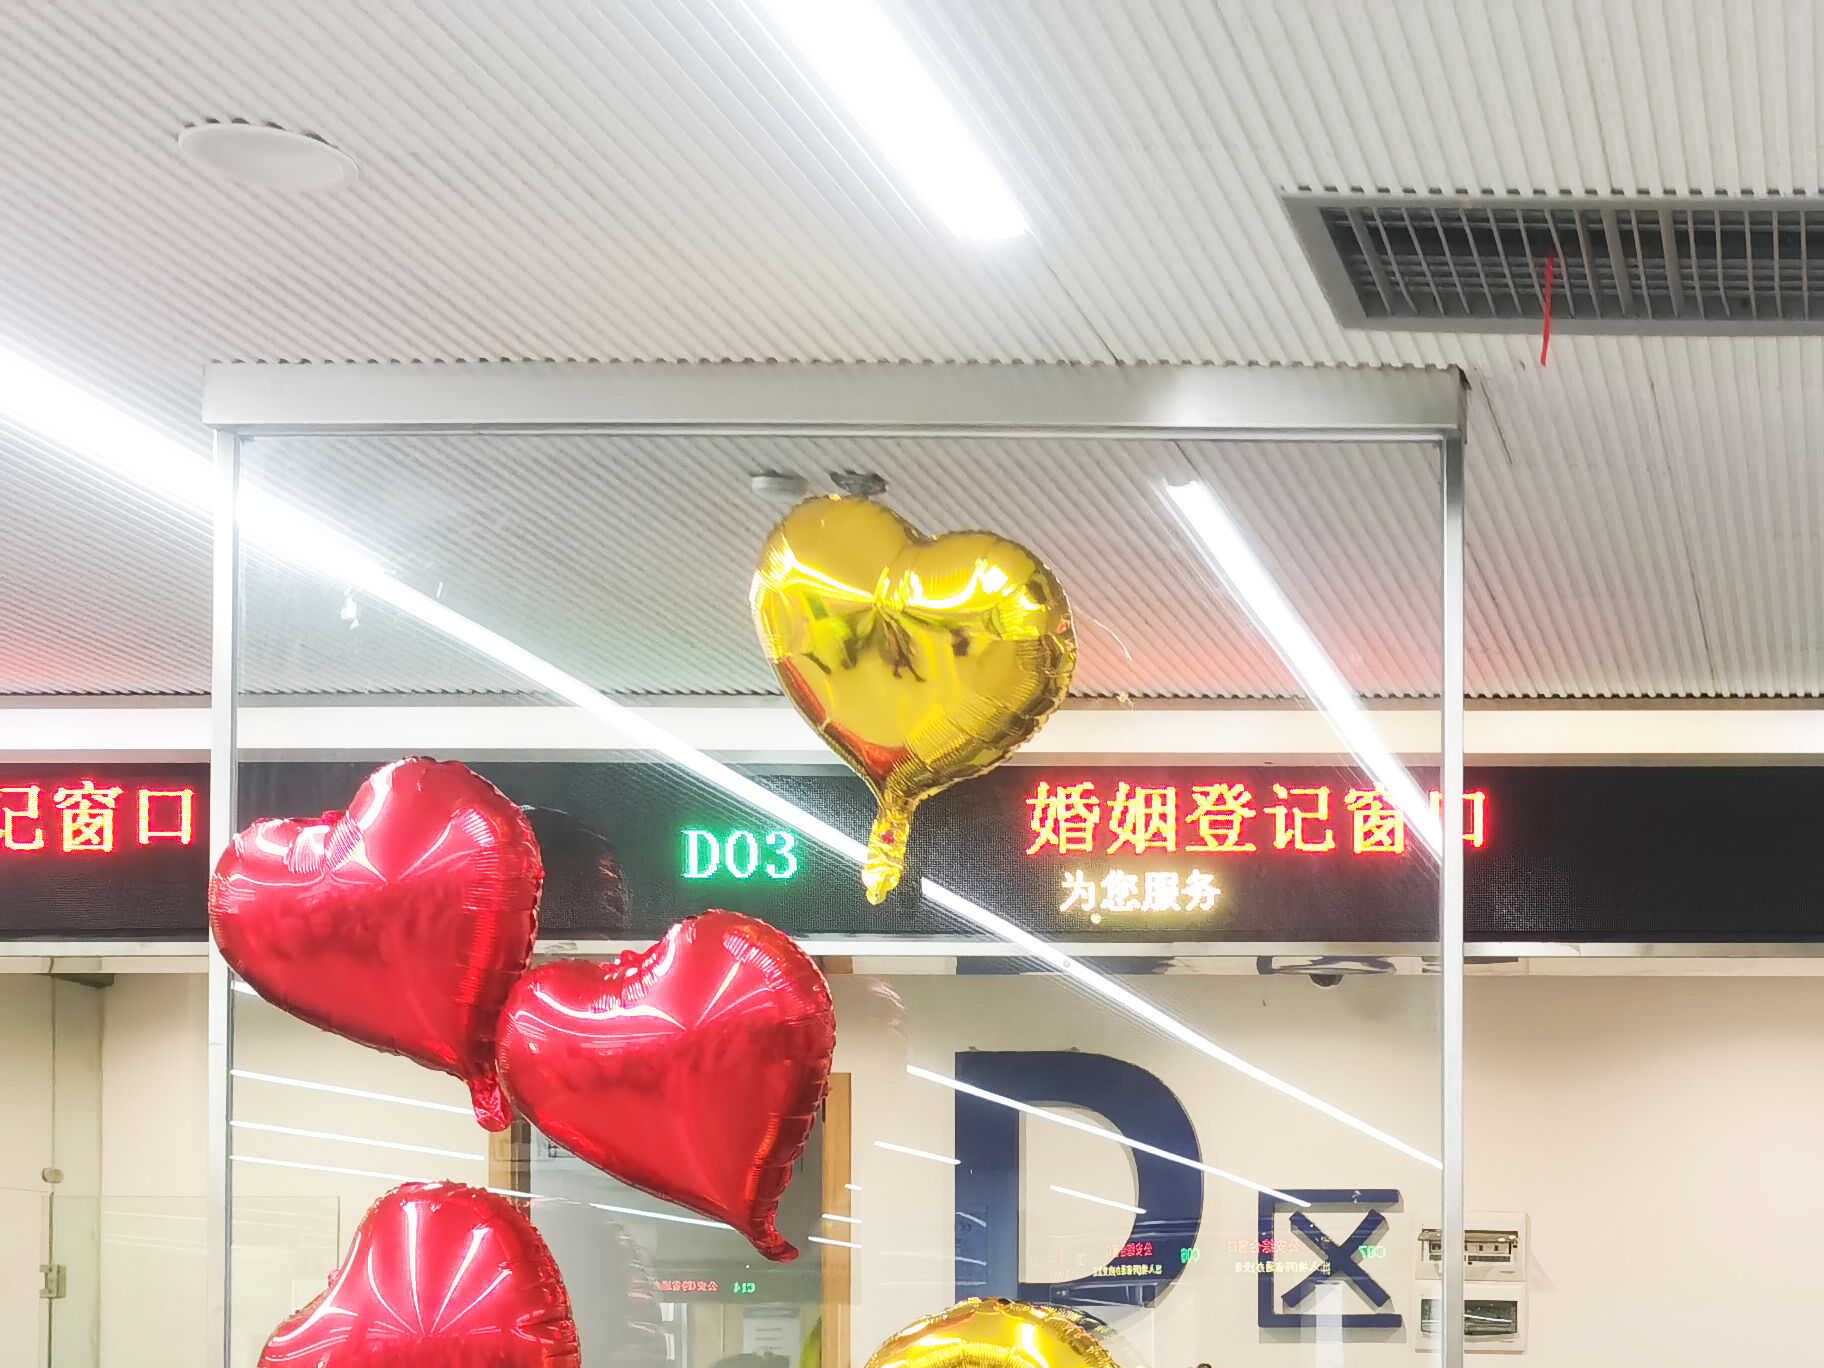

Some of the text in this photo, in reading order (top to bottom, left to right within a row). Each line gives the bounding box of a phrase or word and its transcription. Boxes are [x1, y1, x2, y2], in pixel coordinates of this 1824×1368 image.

[682, 828, 800, 879] D03
[1060, 868, 1221, 912] 为您服务
